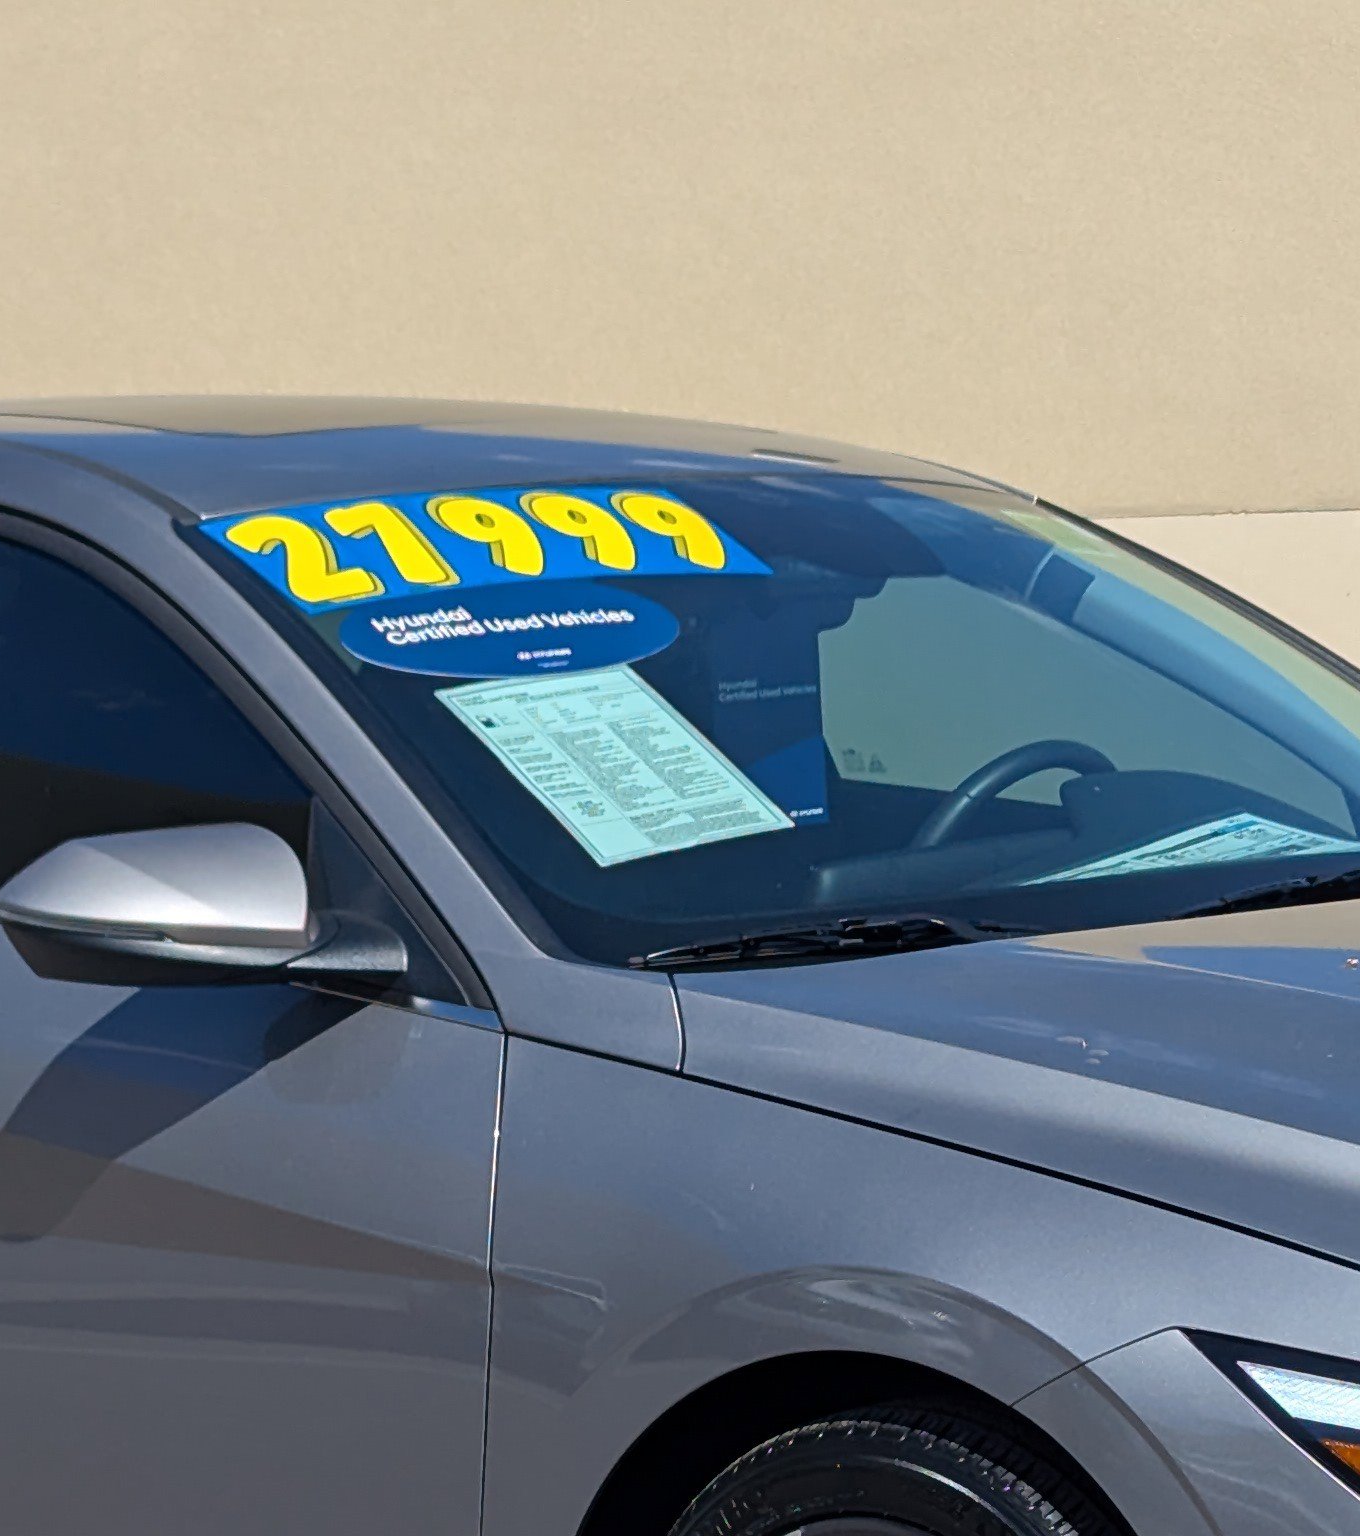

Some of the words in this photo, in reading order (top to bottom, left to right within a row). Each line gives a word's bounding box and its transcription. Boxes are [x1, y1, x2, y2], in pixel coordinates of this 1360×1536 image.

[226, 492, 726, 603] 27999
[370, 605, 472, 632] Hyundai
[386, 623, 485, 644] Certified
[483, 613, 542, 633] Used
[541, 608, 635, 628] Vehicles
